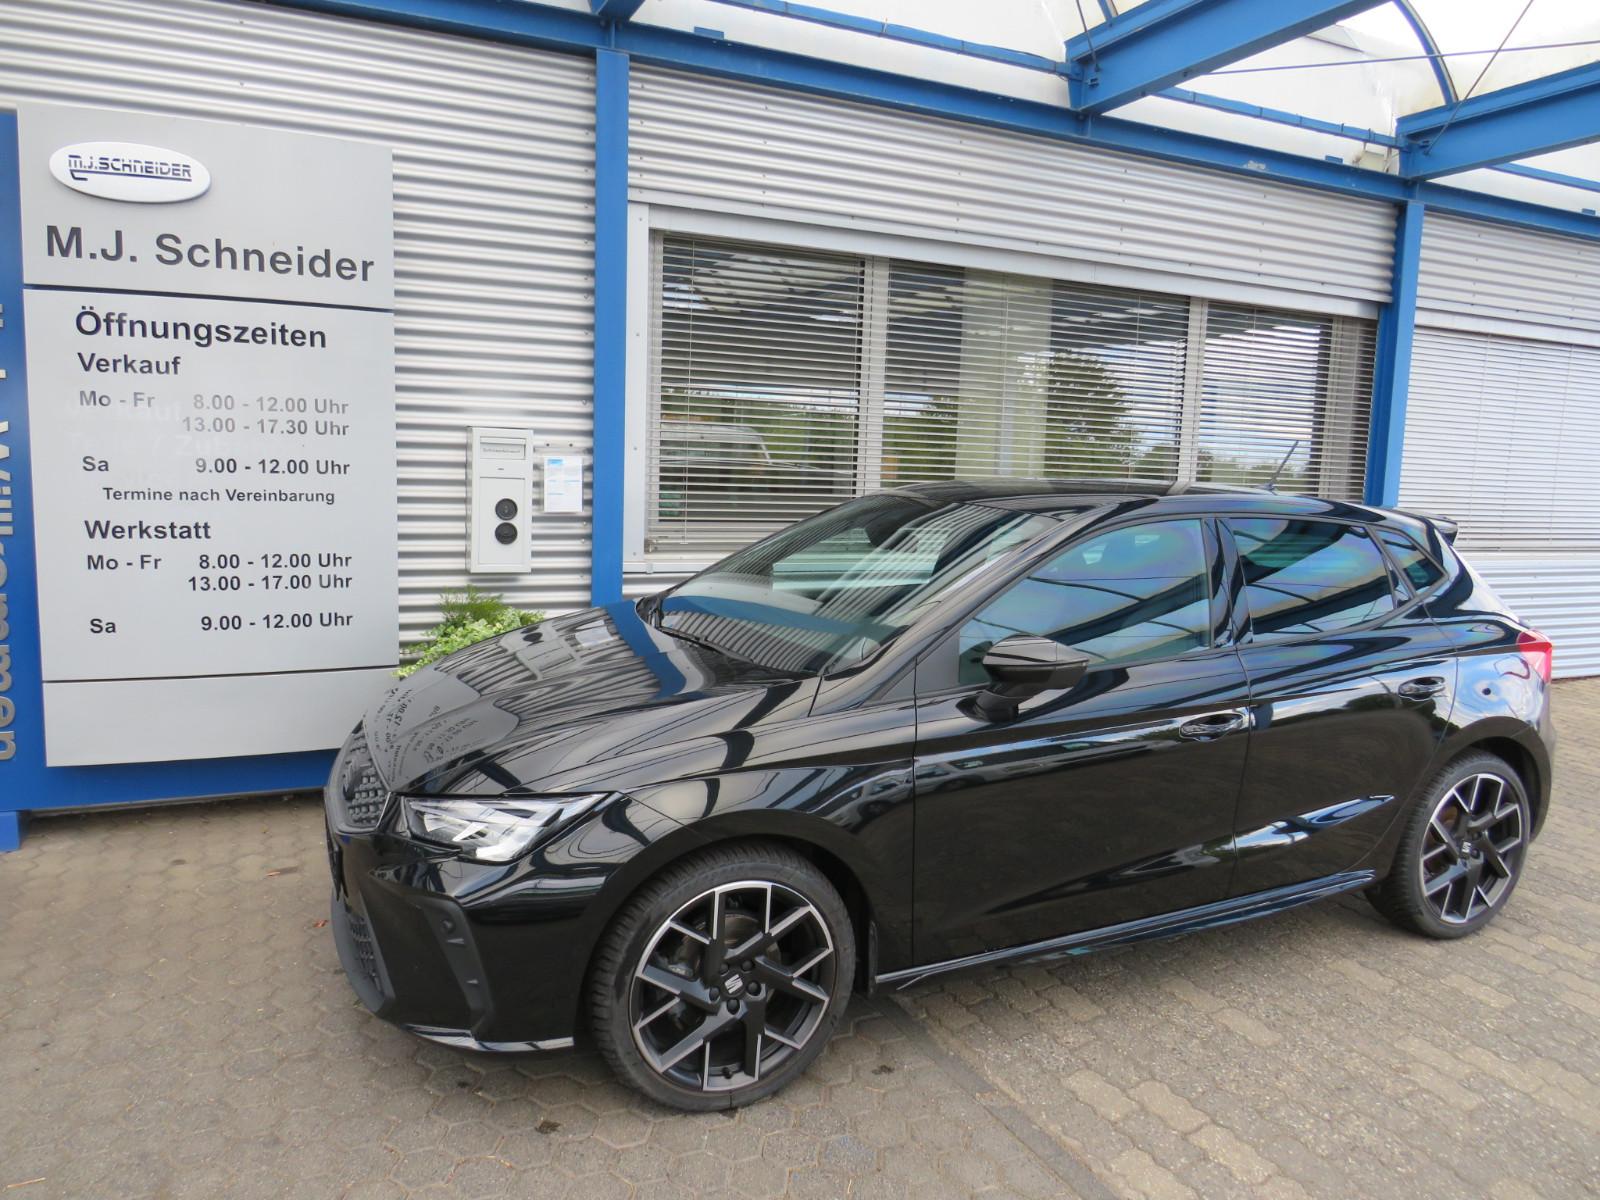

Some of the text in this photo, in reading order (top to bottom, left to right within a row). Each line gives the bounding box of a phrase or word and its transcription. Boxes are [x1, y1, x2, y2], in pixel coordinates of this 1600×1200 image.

[46, 224, 375, 282] M.J. Schneider
[75, 305, 327, 348] Öffnungszeiten
[76, 352, 182, 375] Verkauf
[79, 390, 112, 407] Mo
[132, 391, 156, 408] Fr
[193, 393, 235, 411] 8.00
[256, 396, 308, 414] 12.00
[314, 398, 349, 415] Uhr
[182, 416, 236, 433] 13.00
[256, 418, 308, 435] 17.30
[315, 420, 350, 436] Uhr
[82, 455, 110, 472] Sa
[195, 457, 238, 474] 9.00
[258, 458, 309, 475] 12.00
[315, 459, 351, 475] Uhr
[101, 487, 335, 506] Termine nach Vereinbarung
[83, 519, 212, 540] Werkstatt
[87, 554, 119, 571] Mo
[140, 554, 162, 570] Fr
[199, 553, 240, 570] 8.00
[260, 553, 312, 569] 12.00
[318, 552, 353, 568] Uhr
[188, 575, 241, 592] 13.00
[261, 574, 312, 590] 17.00
[318, 574, 353, 589] Uhr
[89, 618, 117, 634] Sa
[200, 615, 242, 632] 9.00
[262, 612, 313, 629] 12.00
[319, 611, 354, 628] Uhr
